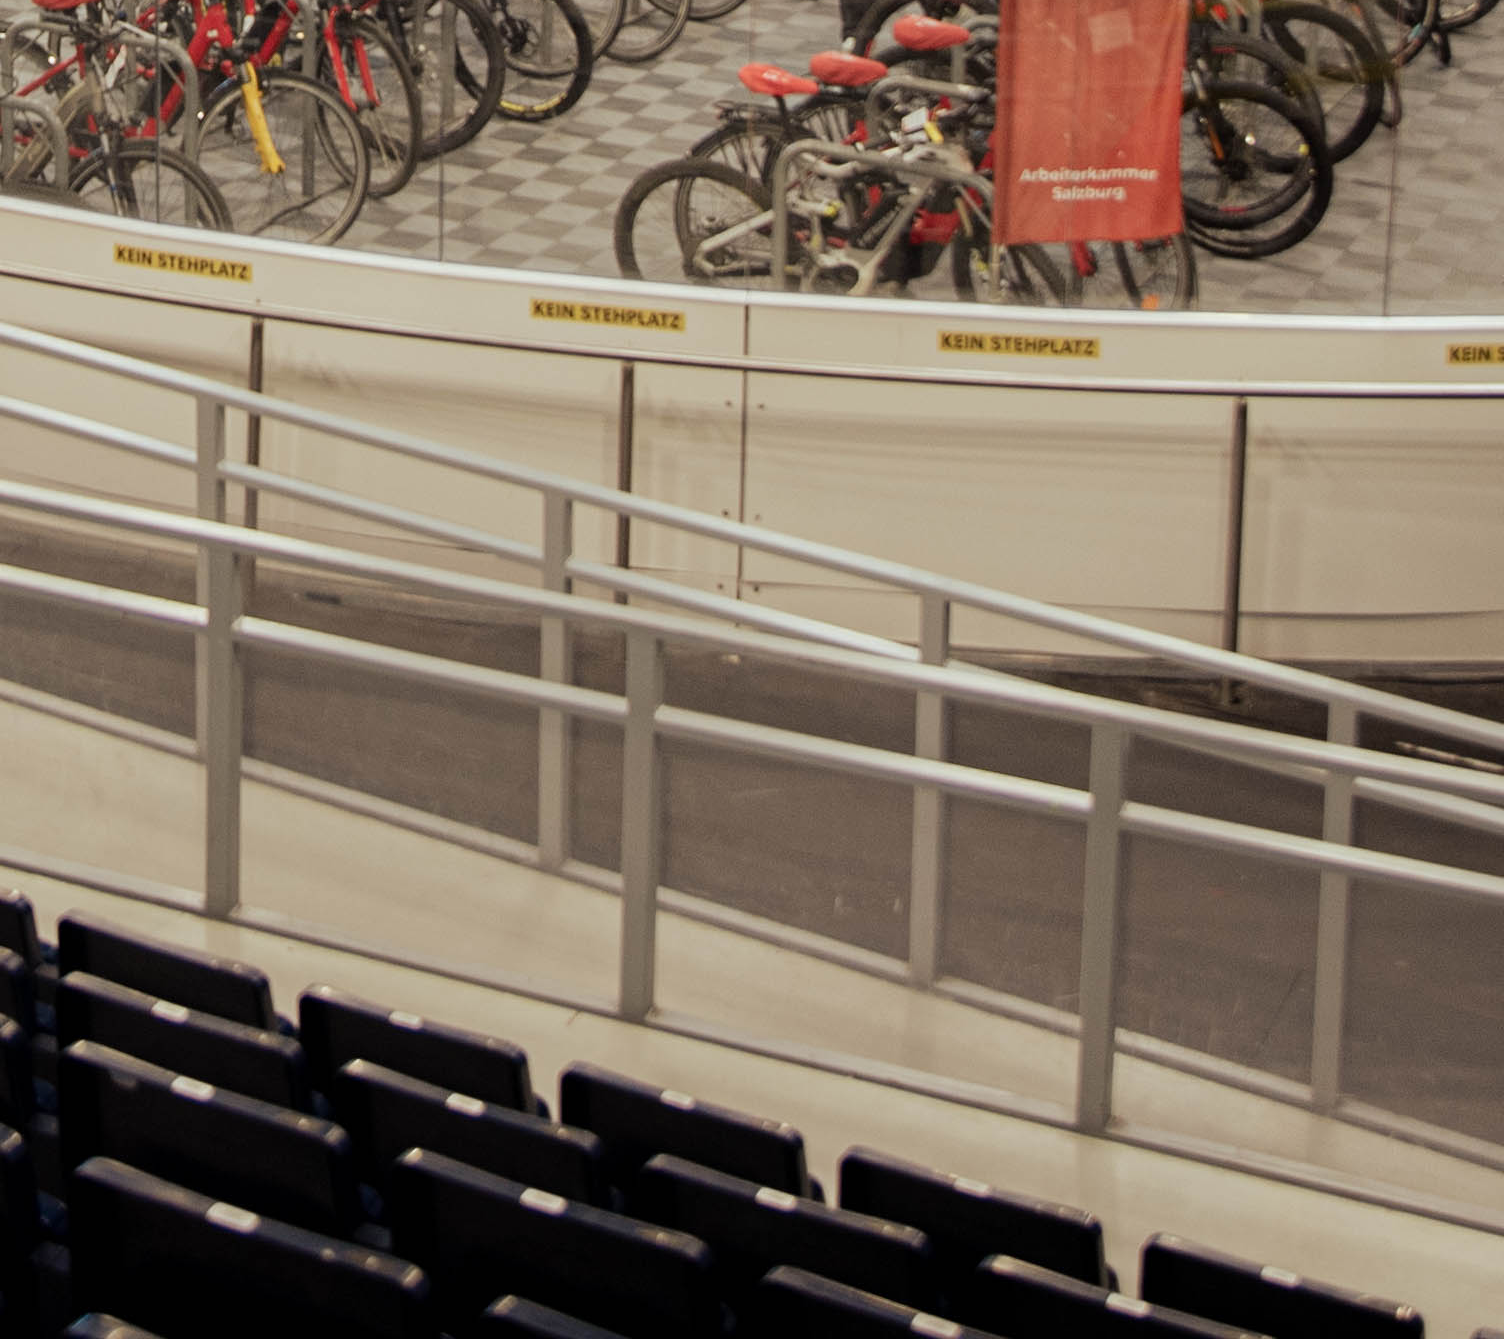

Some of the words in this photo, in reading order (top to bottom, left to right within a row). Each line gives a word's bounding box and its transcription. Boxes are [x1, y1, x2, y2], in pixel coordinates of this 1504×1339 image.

[1019, 166, 1159, 182] Arbeiterkammer
[1051, 186, 1128, 202] Salzburg
[115, 245, 153, 268] KEIN
[158, 251, 249, 281] STEHPLATZ
[532, 301, 573, 319] KEIN
[580, 304, 682, 329] STEHPLATZ
[940, 333, 986, 351] KEIN
[989, 336, 1096, 357] STEHPLATZ
[1449, 347, 1491, 362] KEIN
